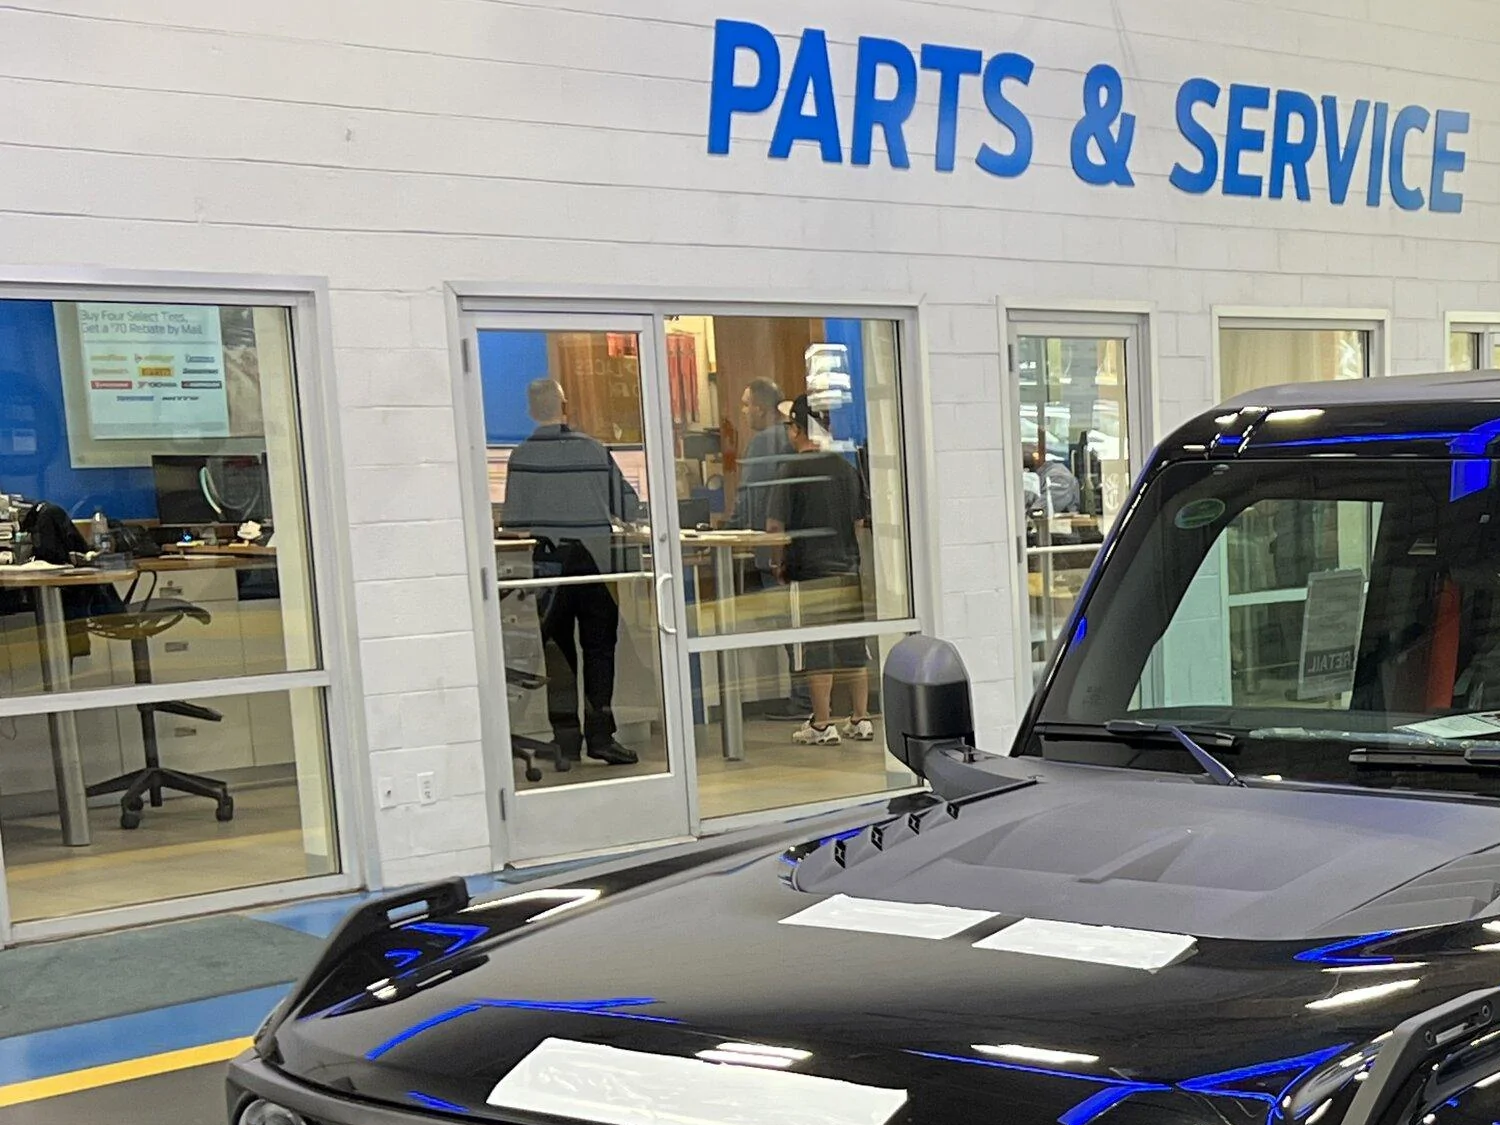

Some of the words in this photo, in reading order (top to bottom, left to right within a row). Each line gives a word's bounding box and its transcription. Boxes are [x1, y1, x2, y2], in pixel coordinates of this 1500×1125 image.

[707, 19, 1034, 178] PARTS
[1070, 63, 1136, 188] &
[1168, 78, 1470, 214] SERVICE
[101, 310, 125, 321] Four
[167, 324, 179, 335] by
